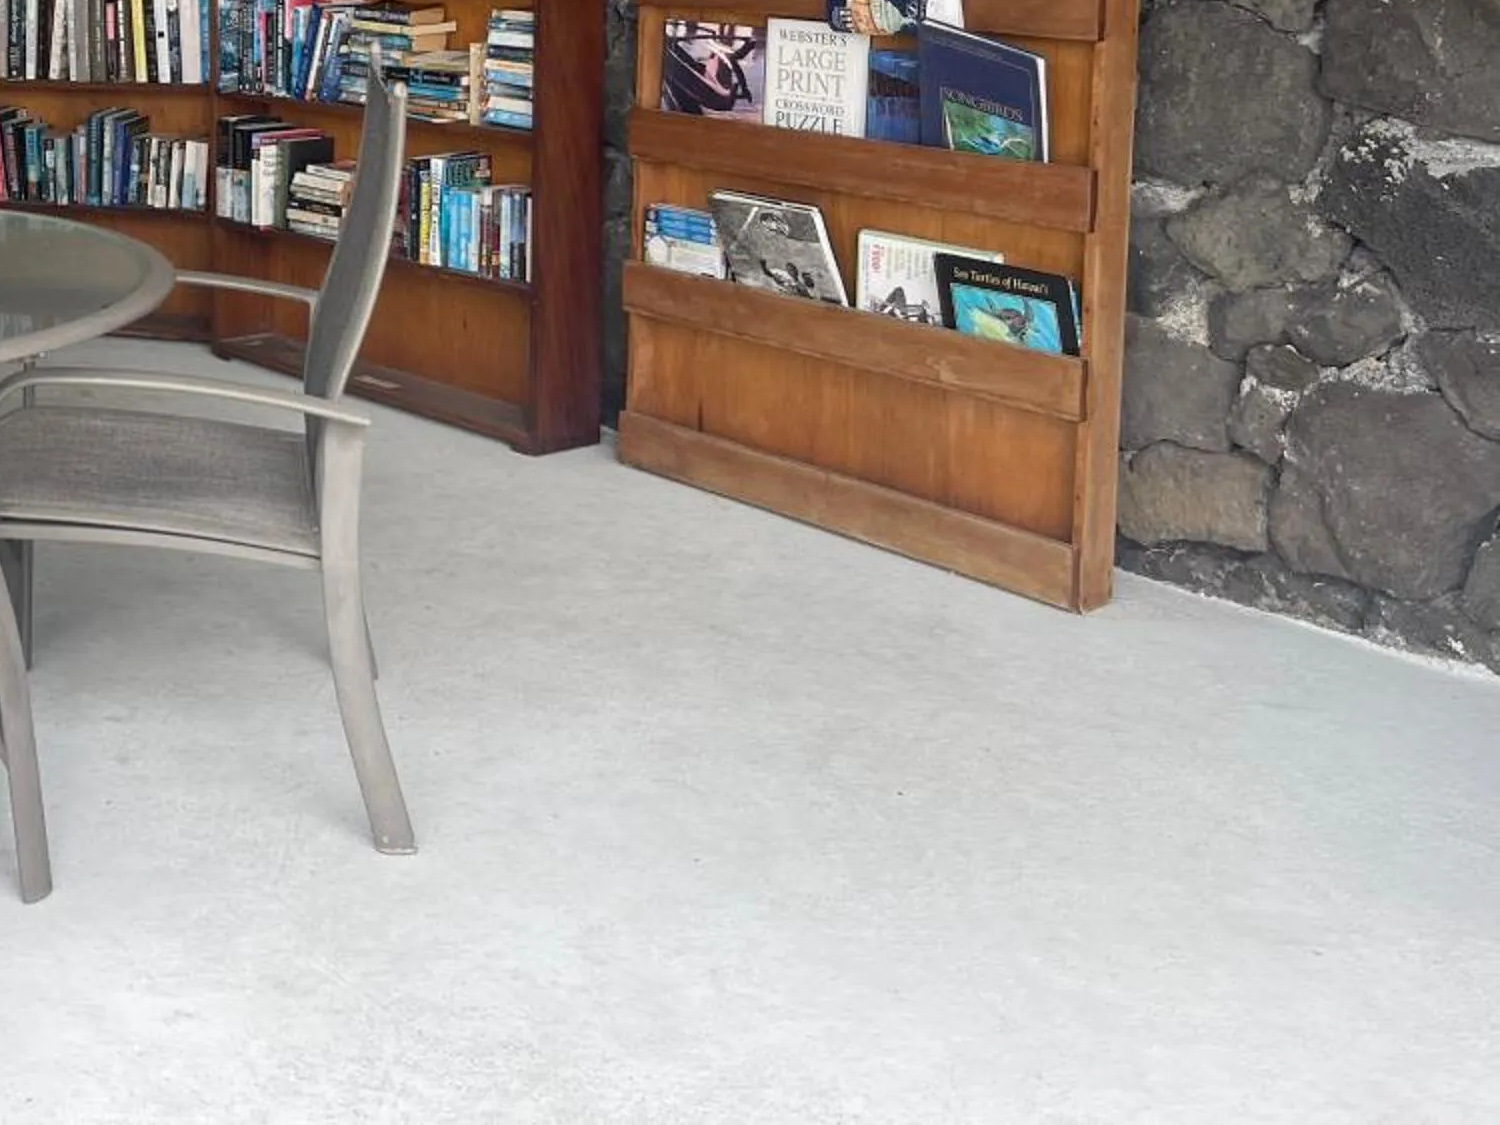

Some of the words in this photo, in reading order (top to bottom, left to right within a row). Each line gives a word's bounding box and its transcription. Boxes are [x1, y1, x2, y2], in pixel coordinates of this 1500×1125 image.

[779, 28, 847, 46] WEBSTER'S
[777, 45, 847, 72] LARGE
[775, 67, 846, 97] PRINT
[775, 98, 845, 116] CROSSWORD
